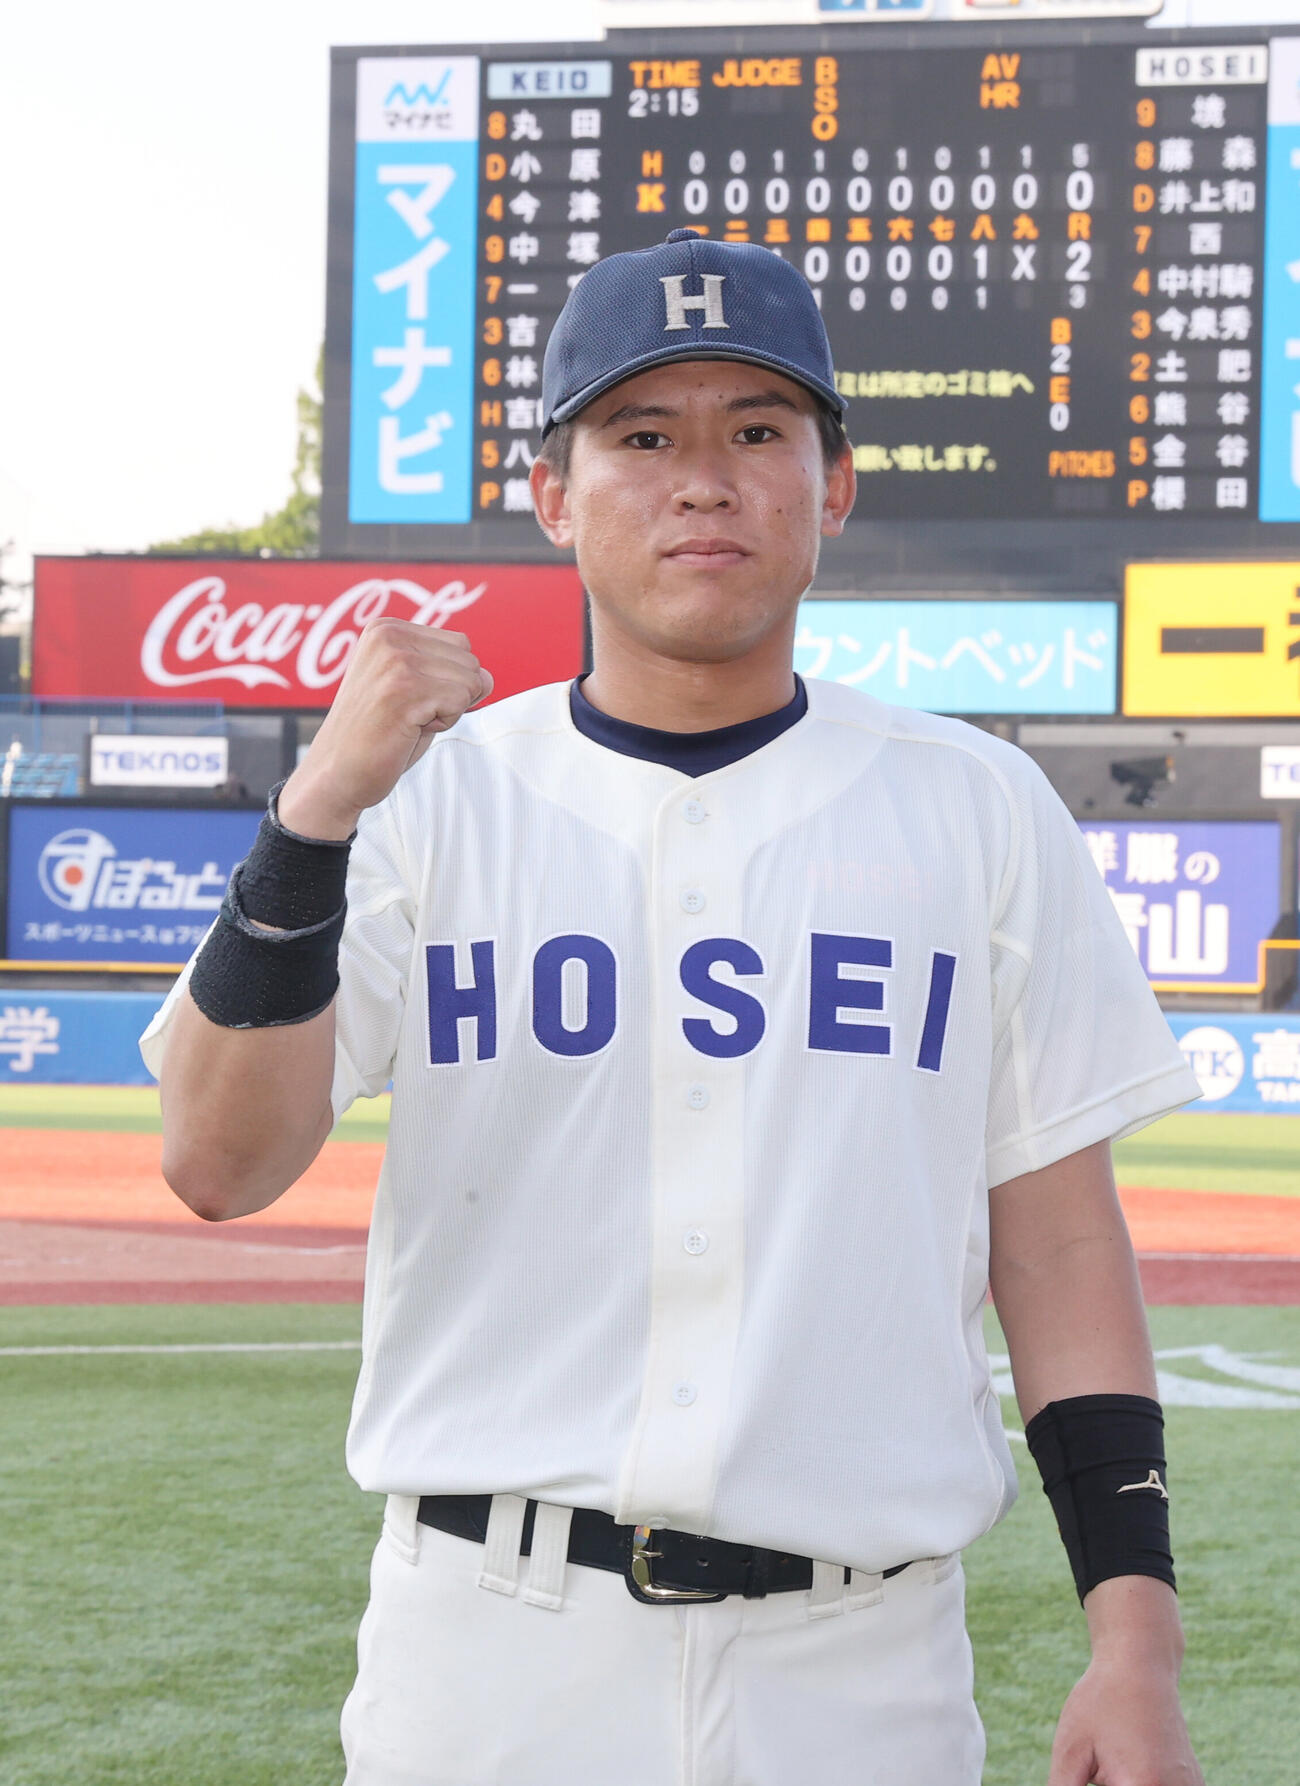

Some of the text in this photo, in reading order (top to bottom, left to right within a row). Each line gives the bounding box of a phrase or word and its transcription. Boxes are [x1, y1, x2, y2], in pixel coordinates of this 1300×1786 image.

[630, 61, 700, 89] TIME
[712, 58, 802, 87] JUDGE
[981, 54, 1020, 83] AV
[1149, 55, 1256, 78] HOSEI
[511, 71, 588, 95] KEIO
[980, 82, 1020, 108] HR
[629, 87, 698, 117] 2:15
[1136, 99, 1155, 127] 9
[488, 109, 600, 140] 8 丸田
[486, 154, 506, 180] D
[642, 143, 1090, 176] H 0 0 1 1 0 1 0 1 1 5
[1135, 141, 1154, 170] 8
[637, 170, 1095, 215] K 0 0 0 0 0 0 0 0 0 0
[1133, 179, 1255, 213] D 井上和
[487, 195, 502, 220] 4
[725, 219, 749, 241] 二
[888, 217, 913, 241] 六
[971, 214, 996, 239] 八
[1068, 212, 1091, 238] R
[1135, 223, 1222, 255] 7 西
[486, 235, 504, 262] 9
[803, 241, 1092, 283] 0 0 0 0 1 X 2
[486, 274, 590, 303] 7 一
[1133, 269, 1150, 296] 4
[658, 274, 730, 333] H
[849, 287, 866, 311] 0
[890, 286, 907, 311] 0
[931, 286, 949, 311] 0
[975, 286, 987, 309] 1
[1068, 284, 1094, 309] 3
[372, 163, 457, 494] マイナビ
[484, 318, 502, 344] 3
[1051, 318, 1071, 345] B
[1132, 310, 1151, 339] 3
[483, 356, 537, 387] 6 林
[1051, 345, 1071, 372] 2
[1130, 349, 1251, 382] 2 土肥
[1050, 376, 1070, 403] E
[481, 396, 543, 430] H 吉
[1050, 405, 1069, 431] 0
[1130, 395, 1149, 423] 6
[482, 440, 499, 468] 5
[1130, 434, 1248, 467] 5 金谷
[480, 482, 500, 508] P
[1128, 480, 1147, 506] P
[141, 576, 487, 690] Coca-Cl
[96, 752, 221, 771] TEKNOS
[423, 929, 960, 1077] HOSEI
